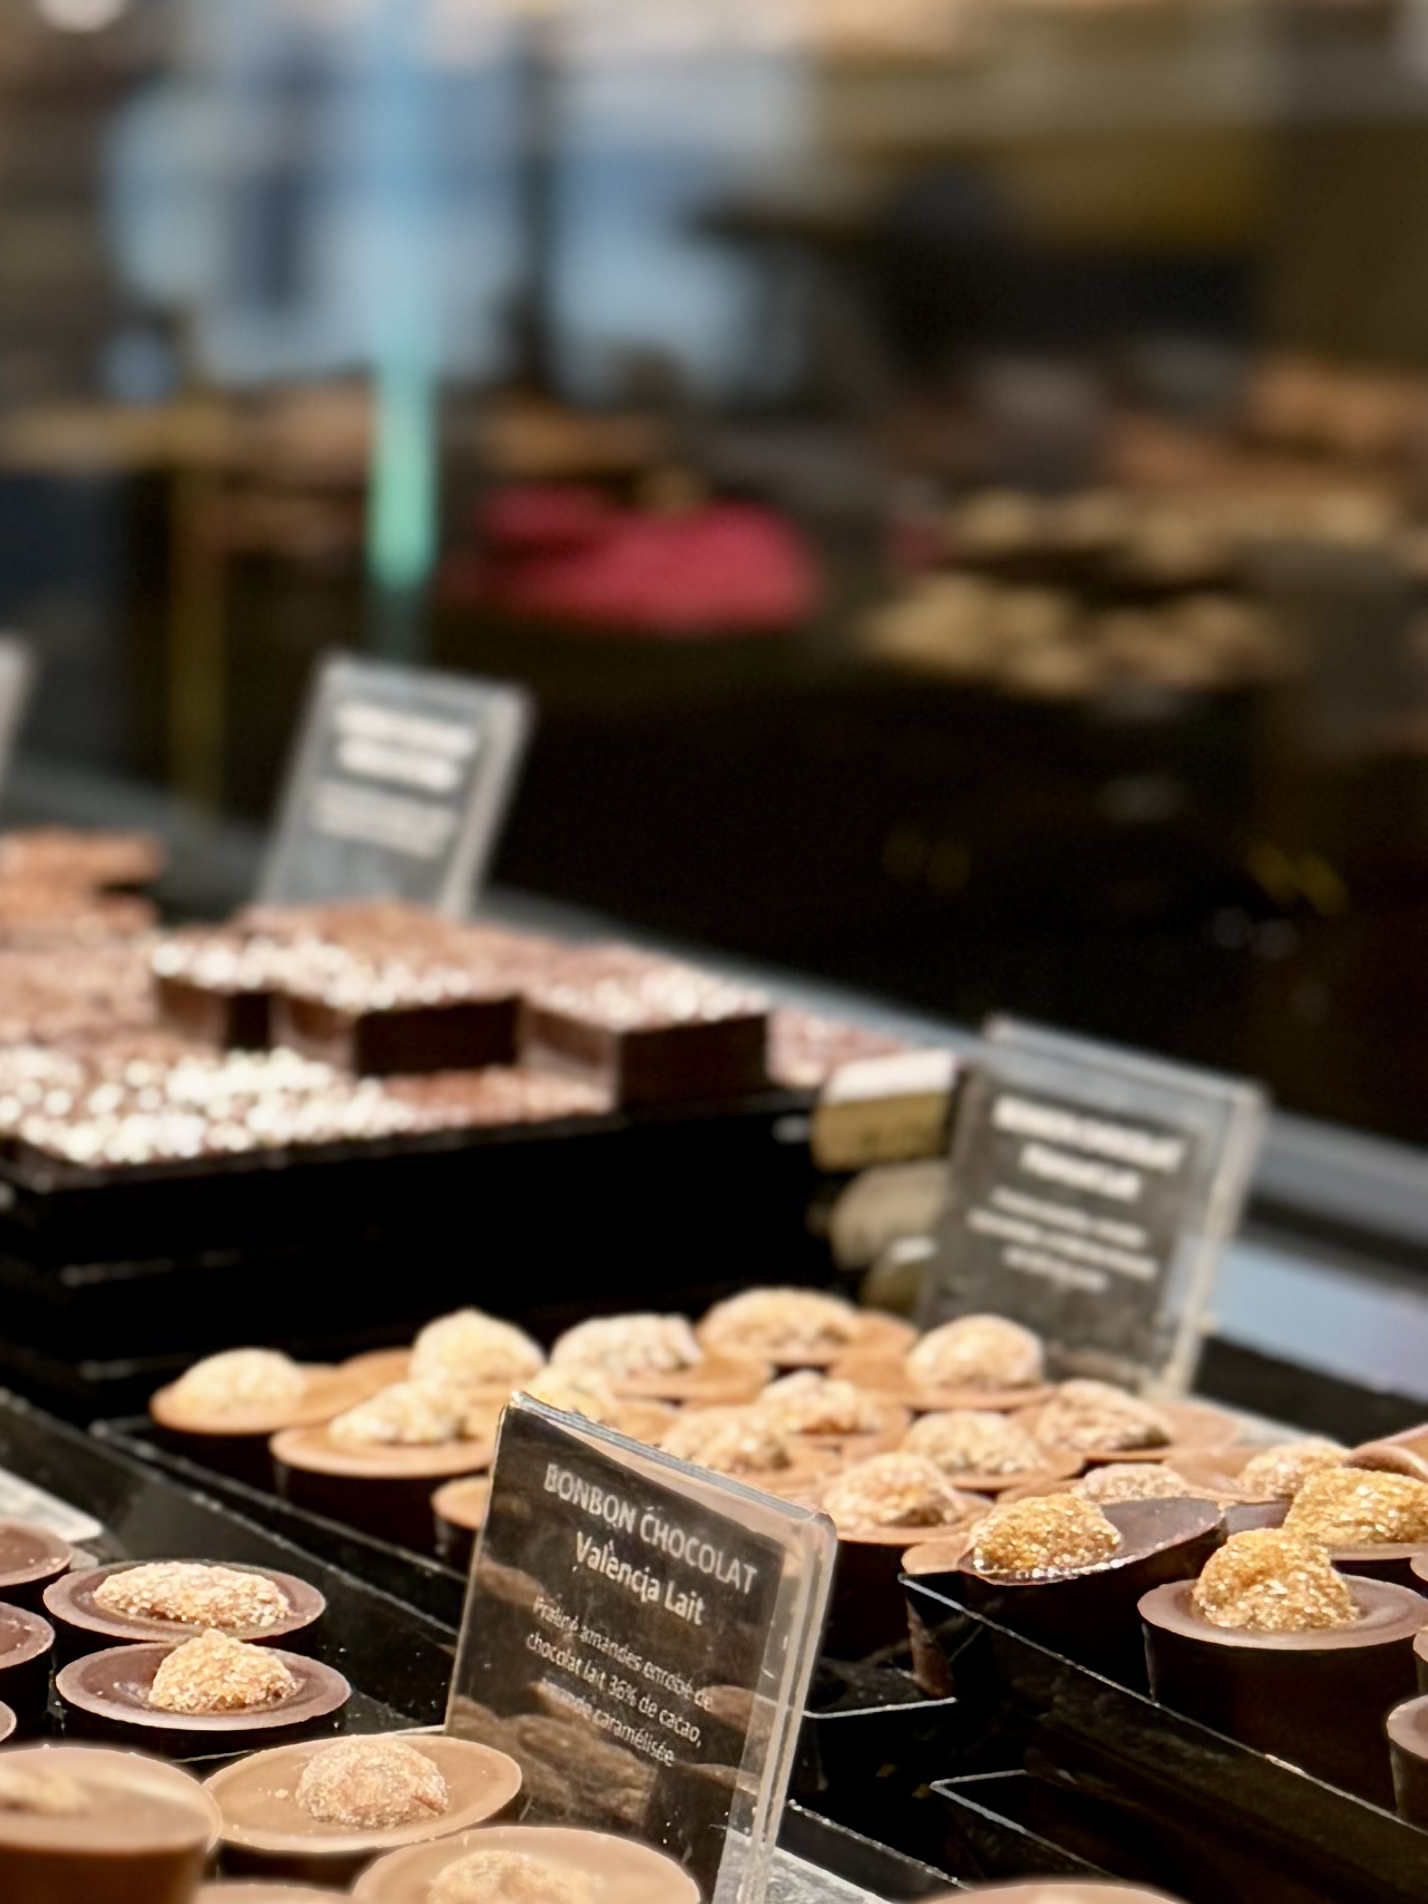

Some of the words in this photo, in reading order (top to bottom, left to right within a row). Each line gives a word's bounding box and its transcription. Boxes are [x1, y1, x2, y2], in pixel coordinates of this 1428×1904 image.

[544, 1463, 637, 1534] BONBON
[639, 1514, 758, 1594] CHOCOLAT
[664, 1580, 706, 1626] Lait
[526, 1630, 584, 1674] chocolat
[583, 1662, 608, 1691] lait
[608, 1674, 639, 1707] 36%
[638, 1694, 658, 1719] de
[659, 1707, 703, 1748] cacao,
[580, 1625, 643, 1672] amandes
[694, 1688, 714, 1712] de
[593, 1709, 676, 1769] caramélisée
